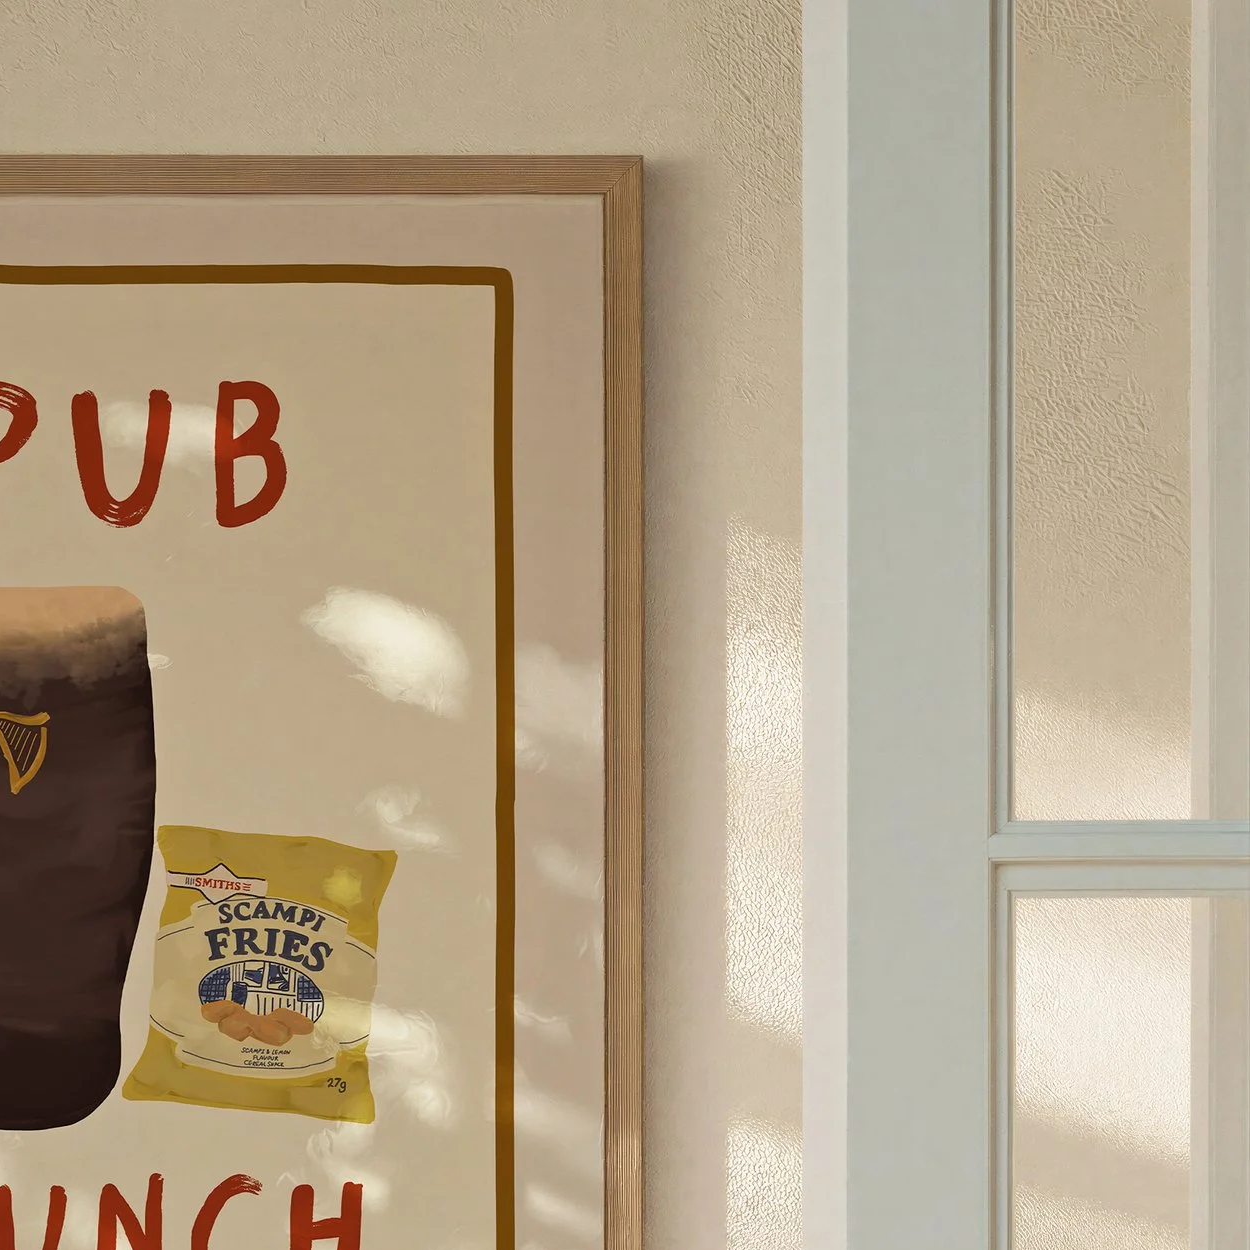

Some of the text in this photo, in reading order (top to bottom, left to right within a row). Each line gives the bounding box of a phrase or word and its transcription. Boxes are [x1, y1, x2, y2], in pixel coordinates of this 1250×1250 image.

[195, 877, 241, 891] SMITHS
[218, 900, 326, 932] SCAMPI
[204, 926, 333, 972] FRIES
[327, 1077, 347, 1093] 27g
